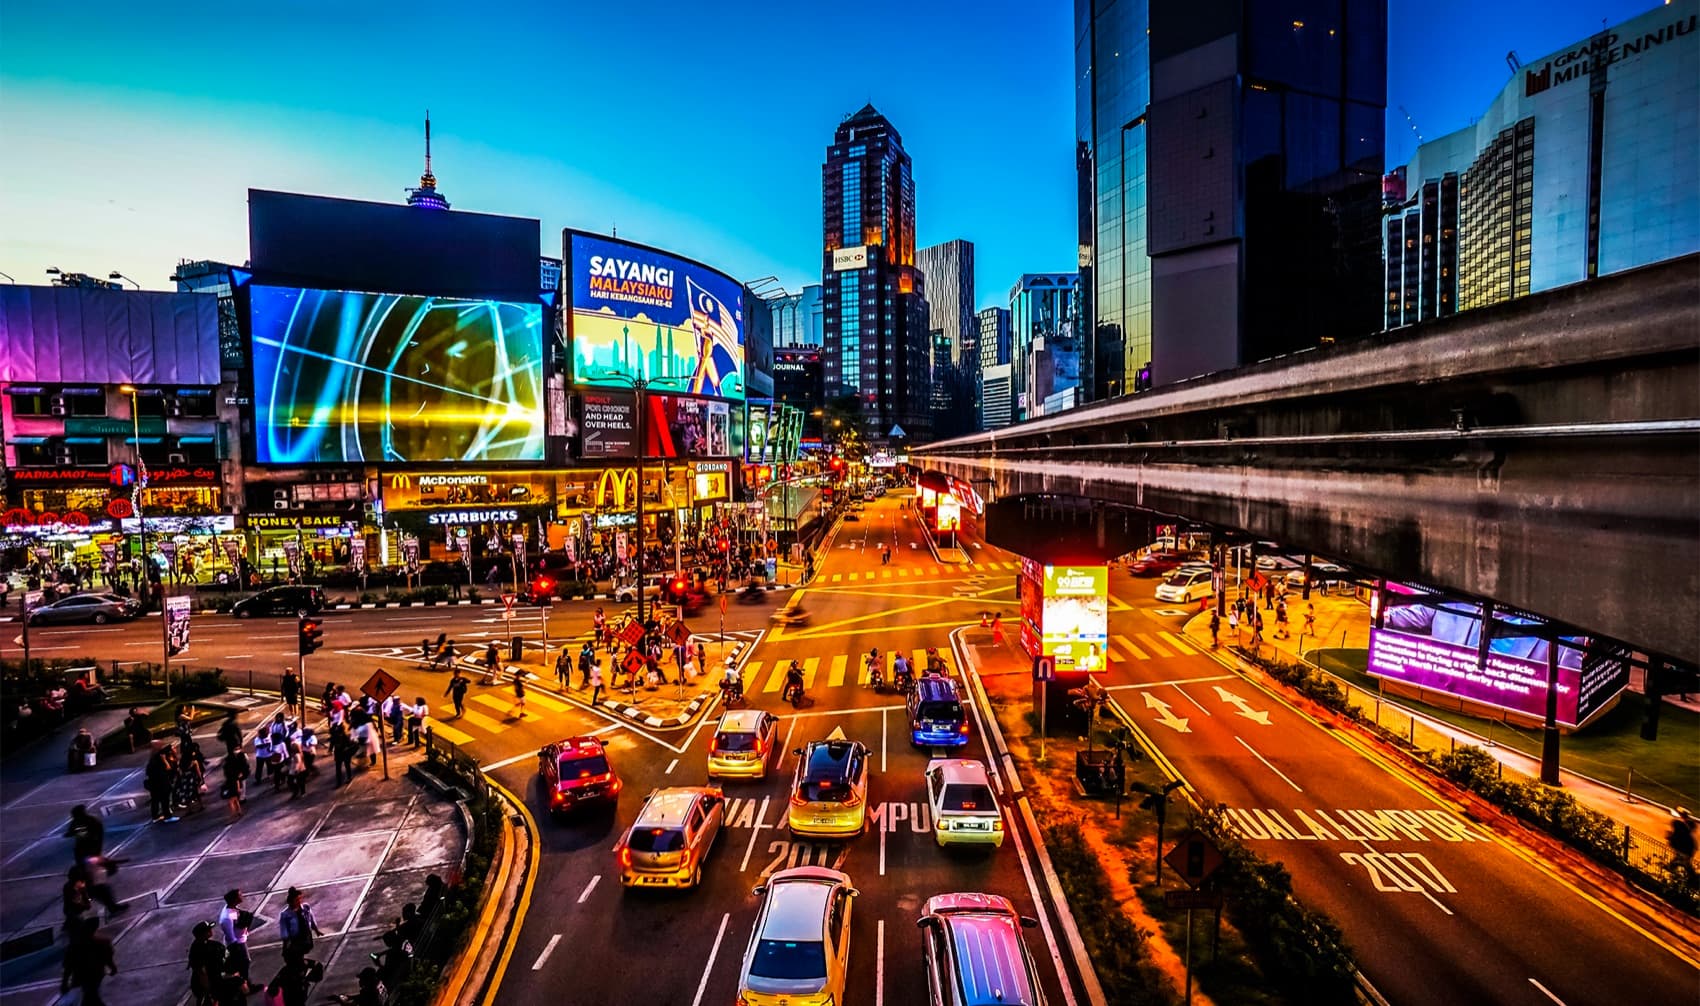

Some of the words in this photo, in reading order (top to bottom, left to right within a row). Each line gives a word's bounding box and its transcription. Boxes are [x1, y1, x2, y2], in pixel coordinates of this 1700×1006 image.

[1554, 34, 1619, 68] GRAND
[835, 255, 853, 264] HSBC
[589, 256, 674, 287] SAYANGI
[589, 277, 673, 300] MALAYSIAKU
[590, 290, 610, 299] HARI
[610, 293, 655, 307] KEBANGSAAN
[772, 363, 805, 371] JOURNAL
[603, 413, 623, 421] HEAD
[15, 470, 87, 479] HADRAMOT
[697, 463, 728, 472] GIORDANO
[419, 476, 487, 485] McDonald's
[247, 517, 298, 526] HONEY
[303, 516, 341, 525] BAKE
[428, 510, 518, 524] STARBUCKS
[1426, 653, 1453, 667] facing
[1492, 659, 1536, 676] Mauricio
[1409, 658, 1433, 671] North
[1433, 663, 1466, 679] London
[1466, 672, 1493, 688] derby
[1493, 679, 1530, 695] against
[1336, 810, 1492, 841] LUMPUR
[1339, 853, 1457, 893] 2017
